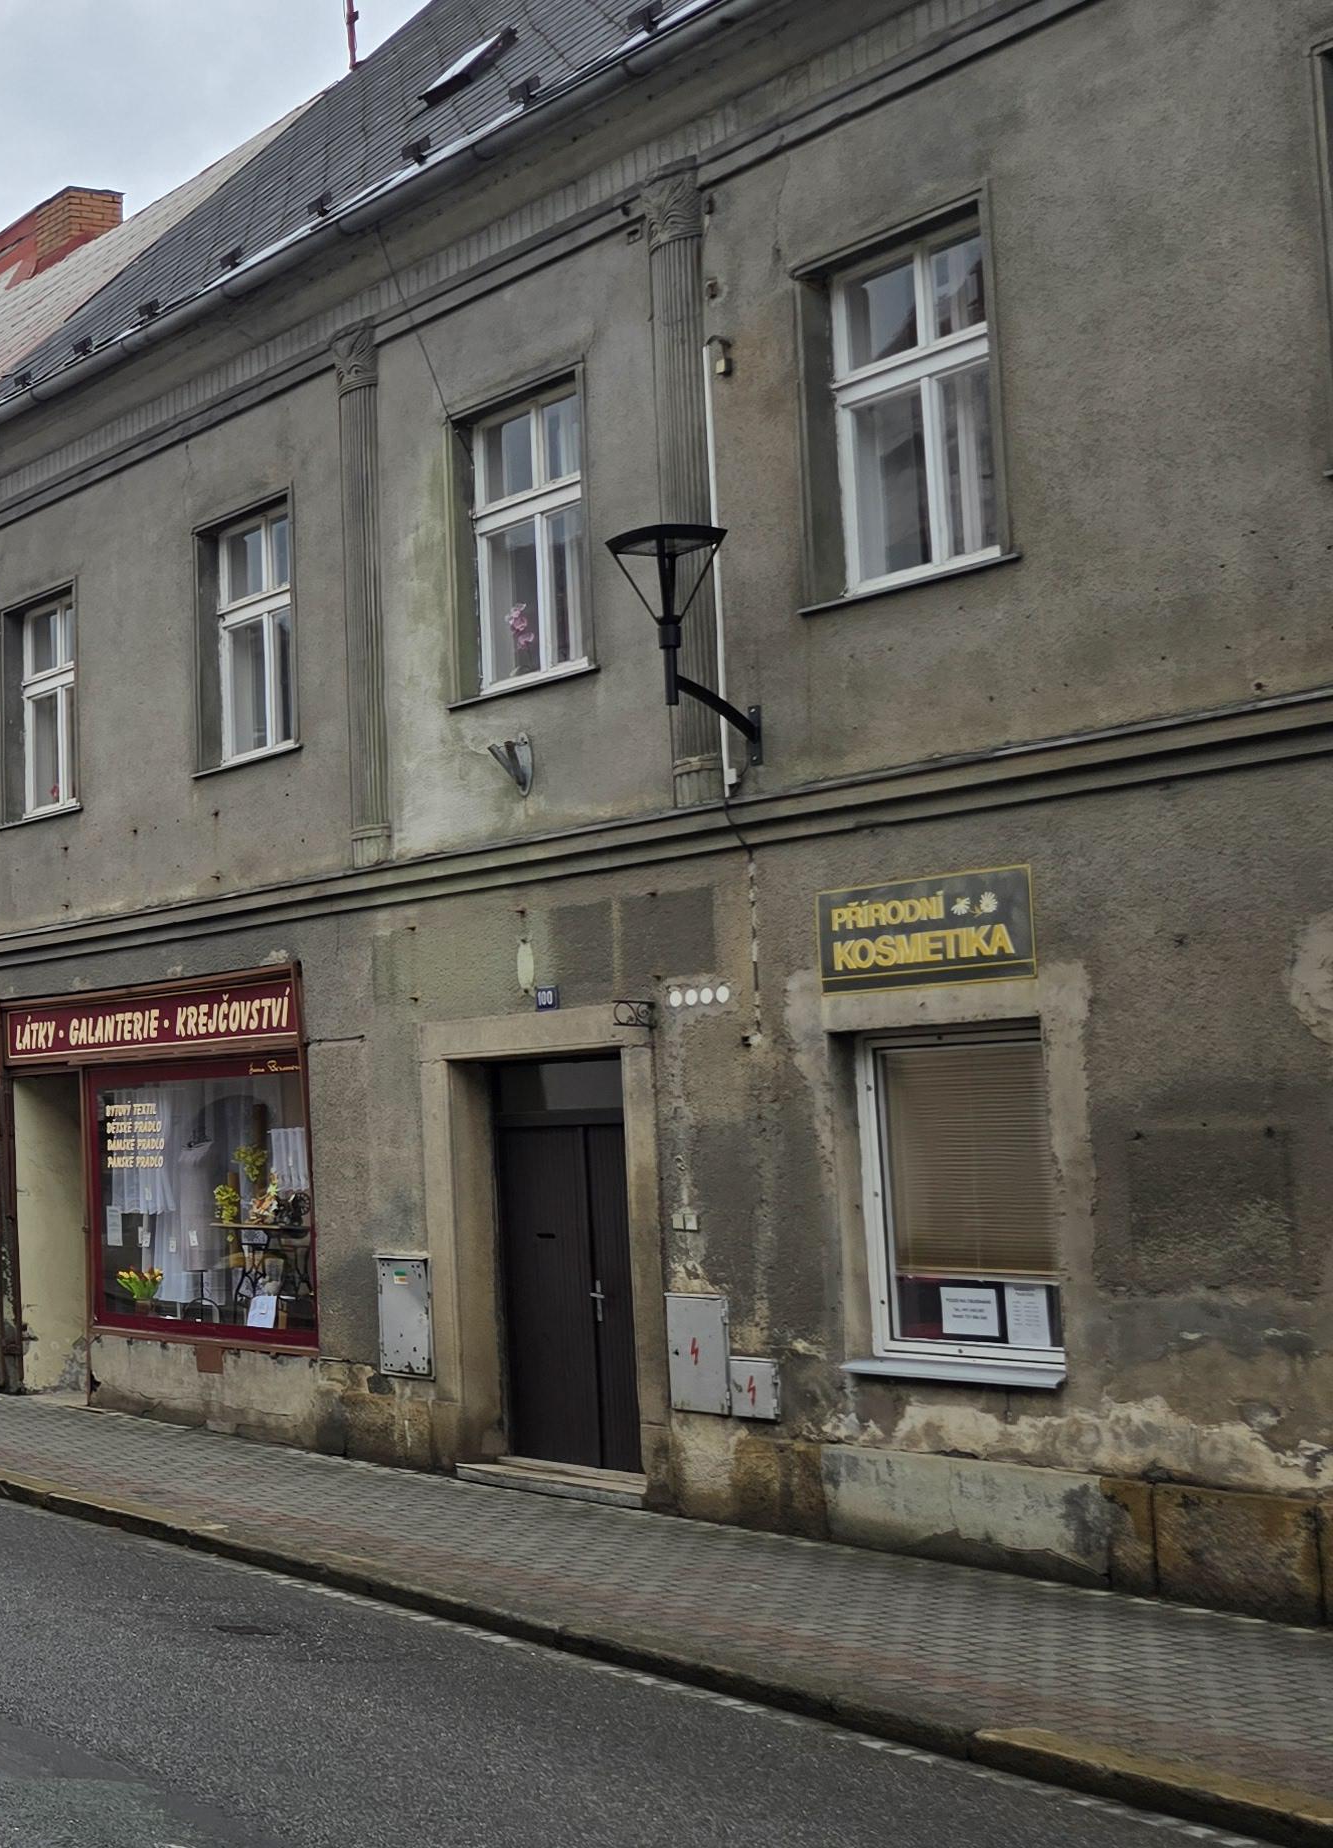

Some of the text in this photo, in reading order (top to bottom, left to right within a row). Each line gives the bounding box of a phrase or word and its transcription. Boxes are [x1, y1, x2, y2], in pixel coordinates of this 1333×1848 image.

[832, 891, 945, 932] PŘÍRODNÍ
[833, 923, 1016, 971] KOSMETIKA
[538, 990, 553, 1006] 100
[16, 987, 290, 1050] LÁTKY GALANTERIE KREJČOVSTVÍ
[105, 1101, 157, 1117] BYTOVÝ TEXTIL
[106, 1117, 162, 1134] DĚTSKÉ PRÁDLO
[107, 1135, 165, 1151] DÁMSKÉ PRÁDLO
[107, 1152, 164, 1168] PÁNSKÉ PRÁDLO
